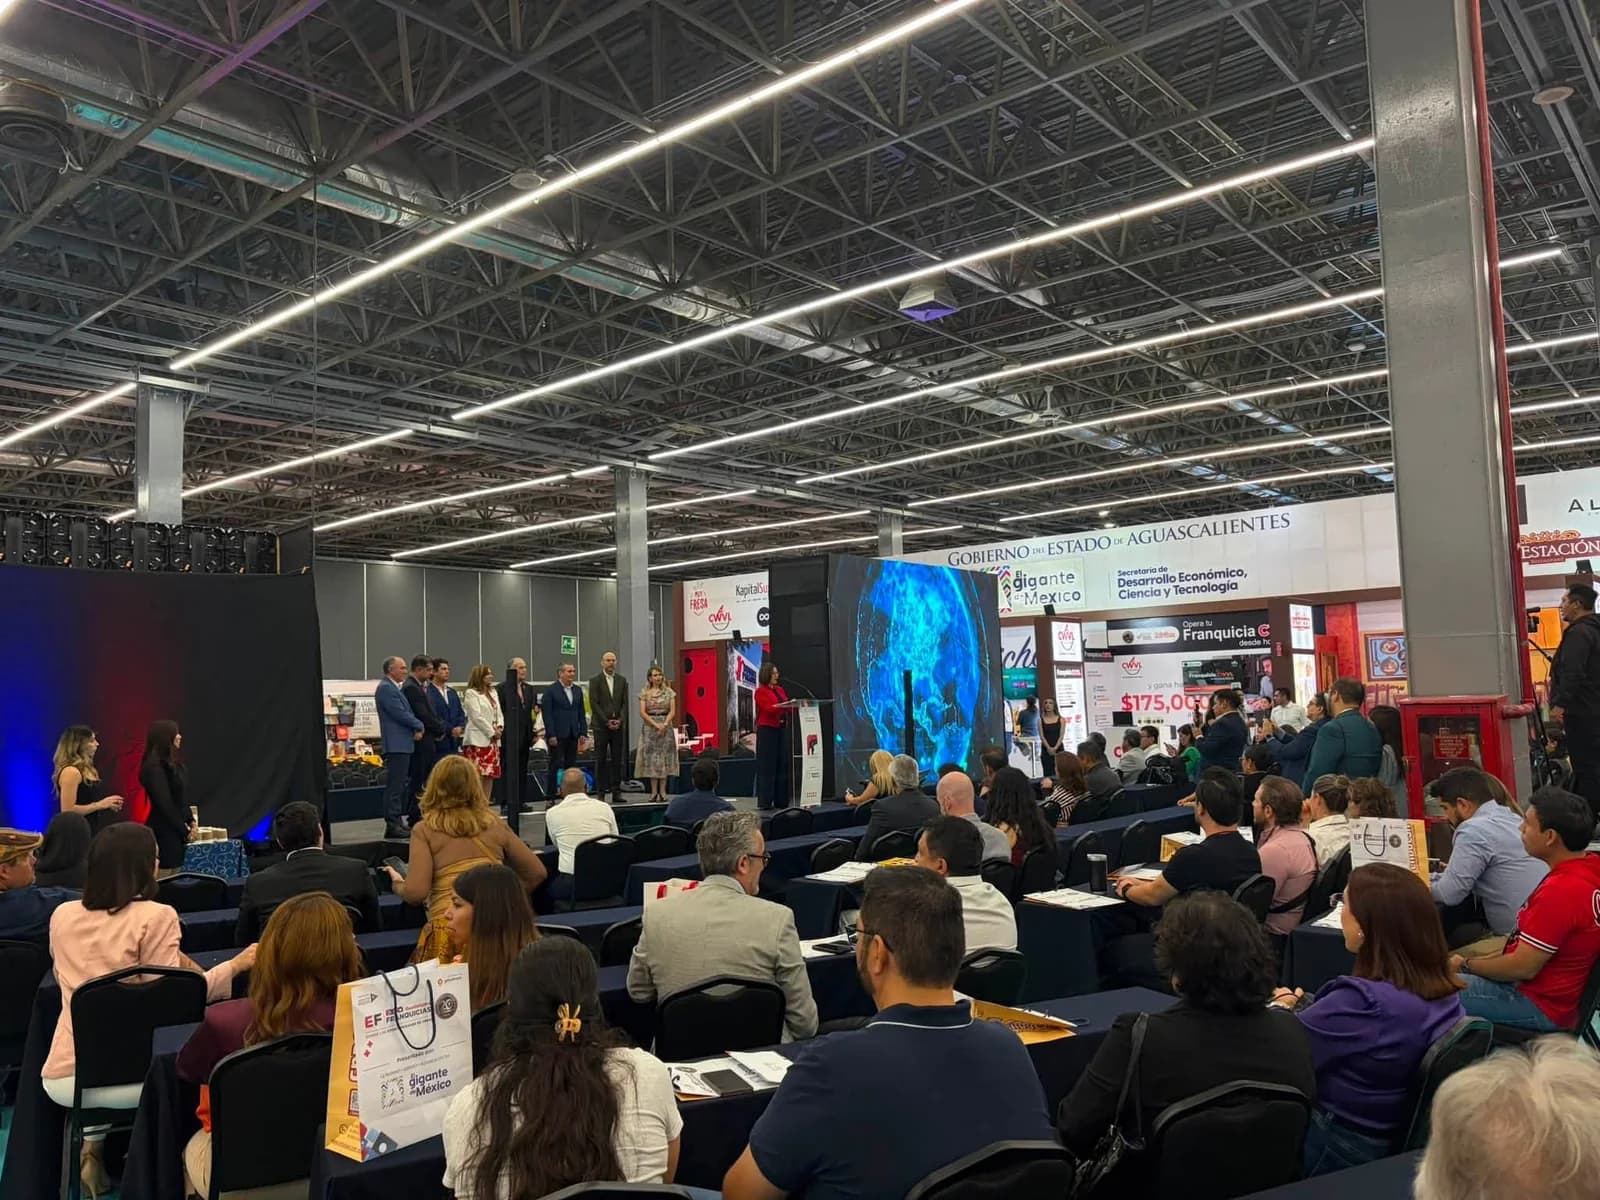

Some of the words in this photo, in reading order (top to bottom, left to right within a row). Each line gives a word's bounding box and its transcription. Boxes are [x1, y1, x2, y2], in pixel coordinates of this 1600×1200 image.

[948, 545, 1030, 567] GOBIERNO
[1047, 535, 1111, 556] ESTADO
[1127, 512, 1291, 547] AGUASCALIENTES
[1520, 539, 1600, 559] ESTACIÓN
[1117, 573, 1177, 588] Desarrollo
[1178, 567, 1248, 583] Económico,
[1158, 565, 1168, 573] de
[1012, 571, 1076, 592] gigante
[1118, 587, 1162, 600] Ciencia
[1163, 587, 1171, 599] y
[1173, 580, 1239, 596] Tecnología
[690, 599, 708, 610] FRESA
[1183, 625, 1256, 642] Franquicia
[364, 1012, 383, 1029] EF
[408, 1067, 449, 1090] gigante
[415, 1078, 452, 1097] México
